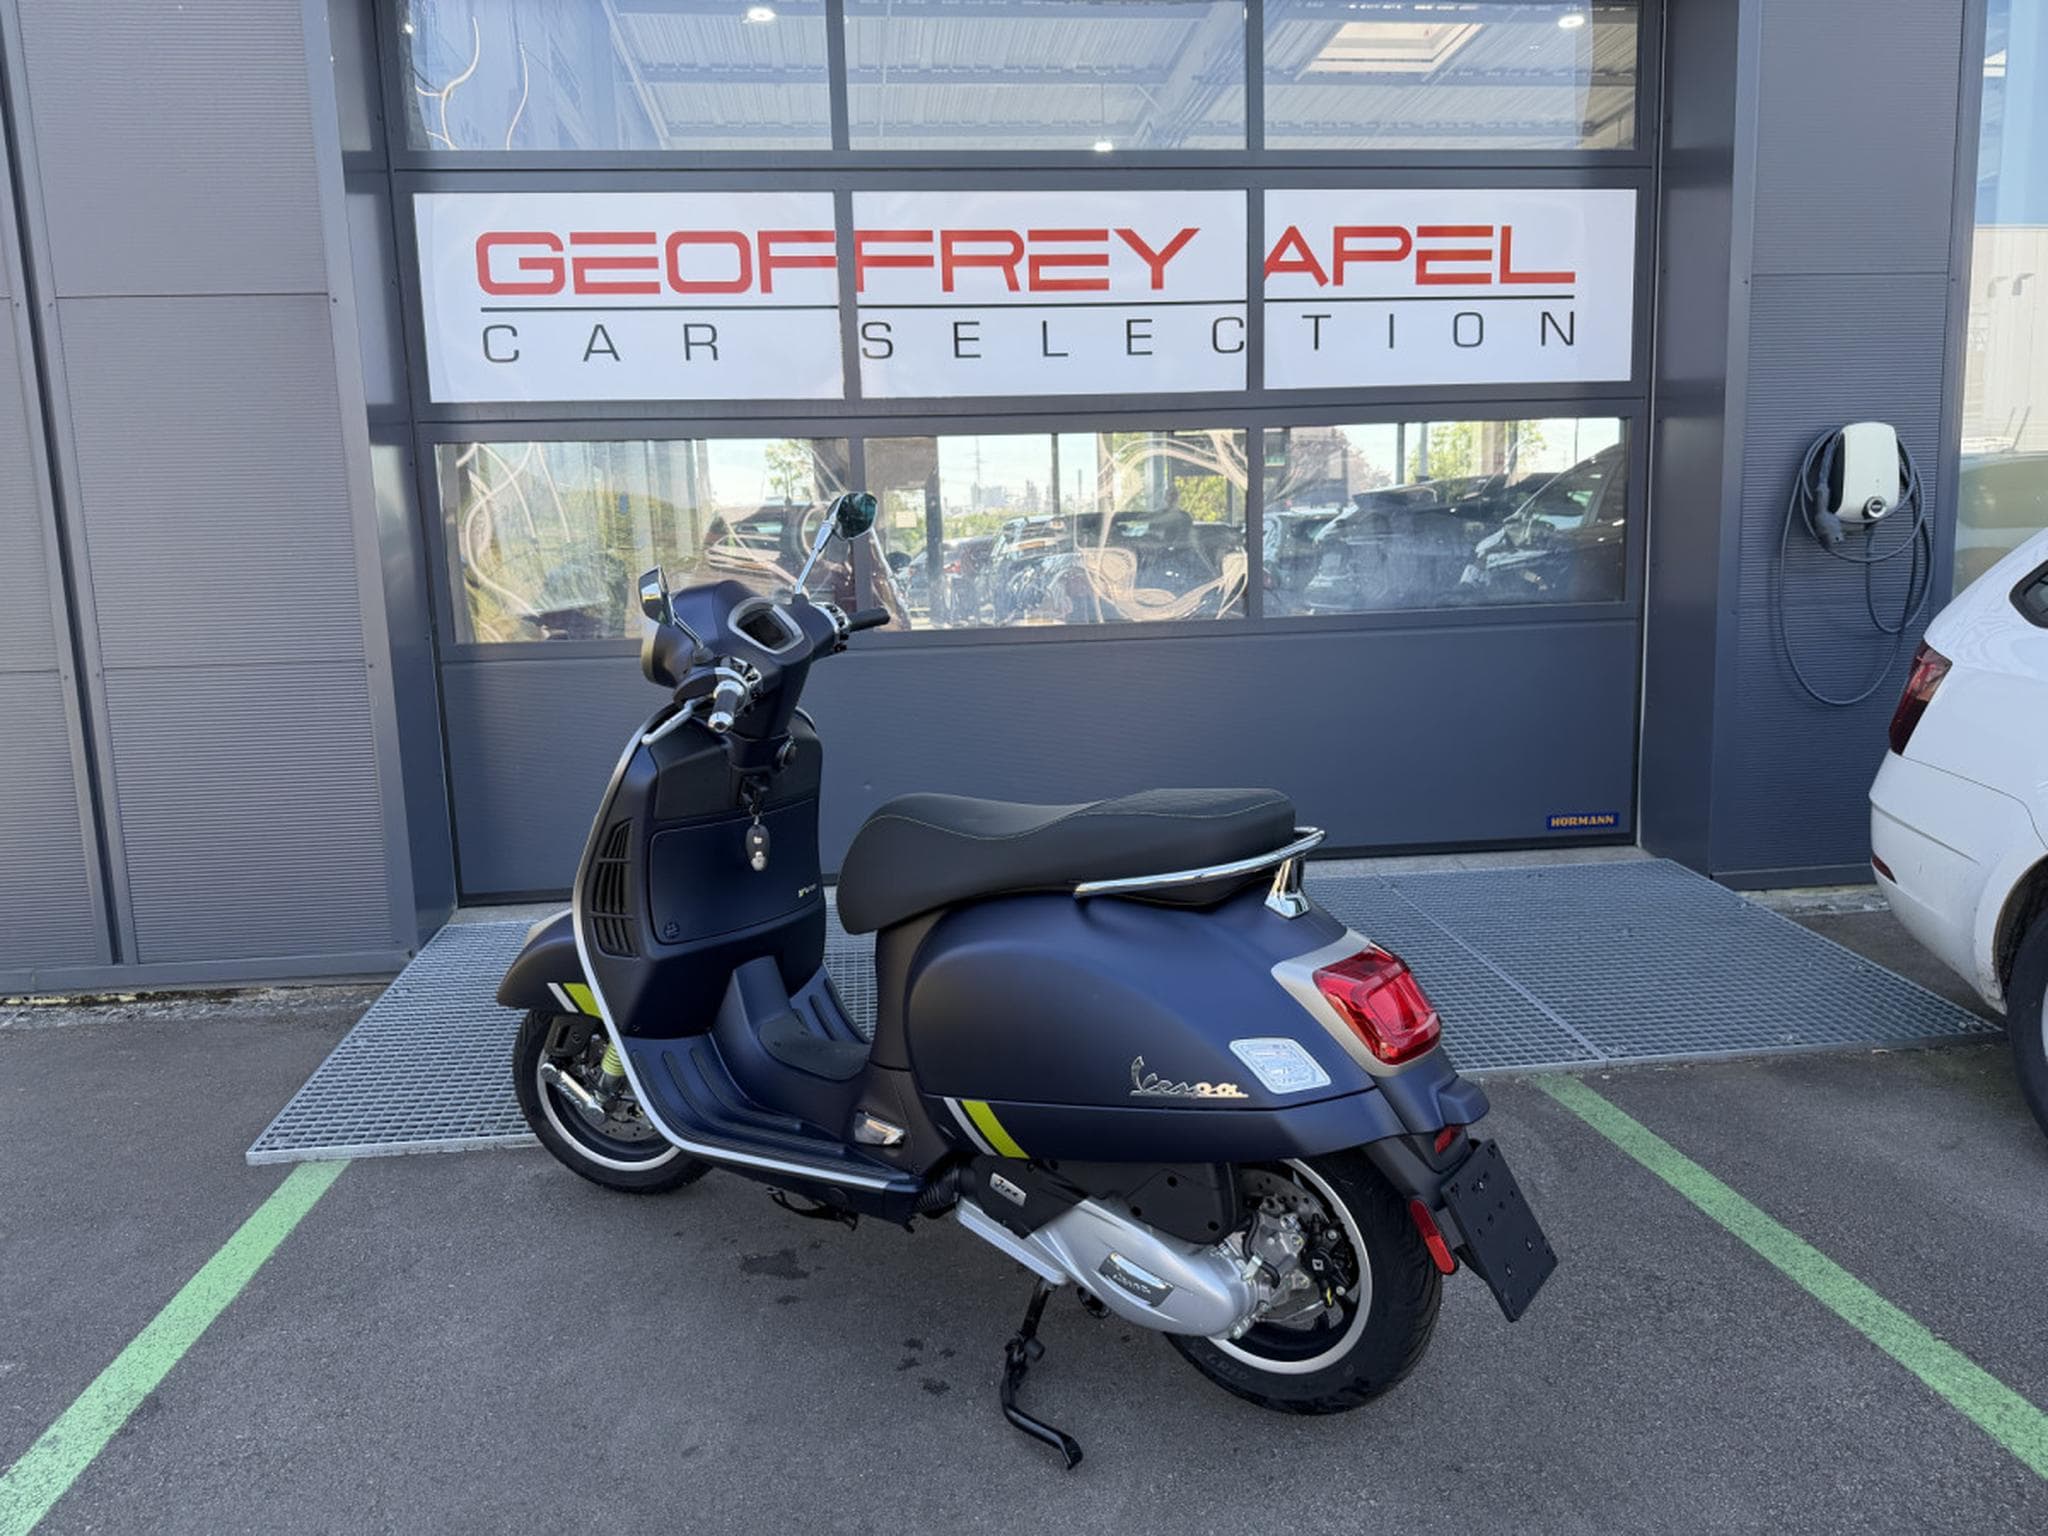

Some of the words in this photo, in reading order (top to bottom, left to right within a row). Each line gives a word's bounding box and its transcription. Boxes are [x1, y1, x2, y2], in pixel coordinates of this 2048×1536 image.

[475, 227, 1200, 295] GEOFFREY
[1264, 225, 1576, 286] APEL
[482, 322, 720, 363] CAR
[861, 310, 1575, 360] SELECTION
